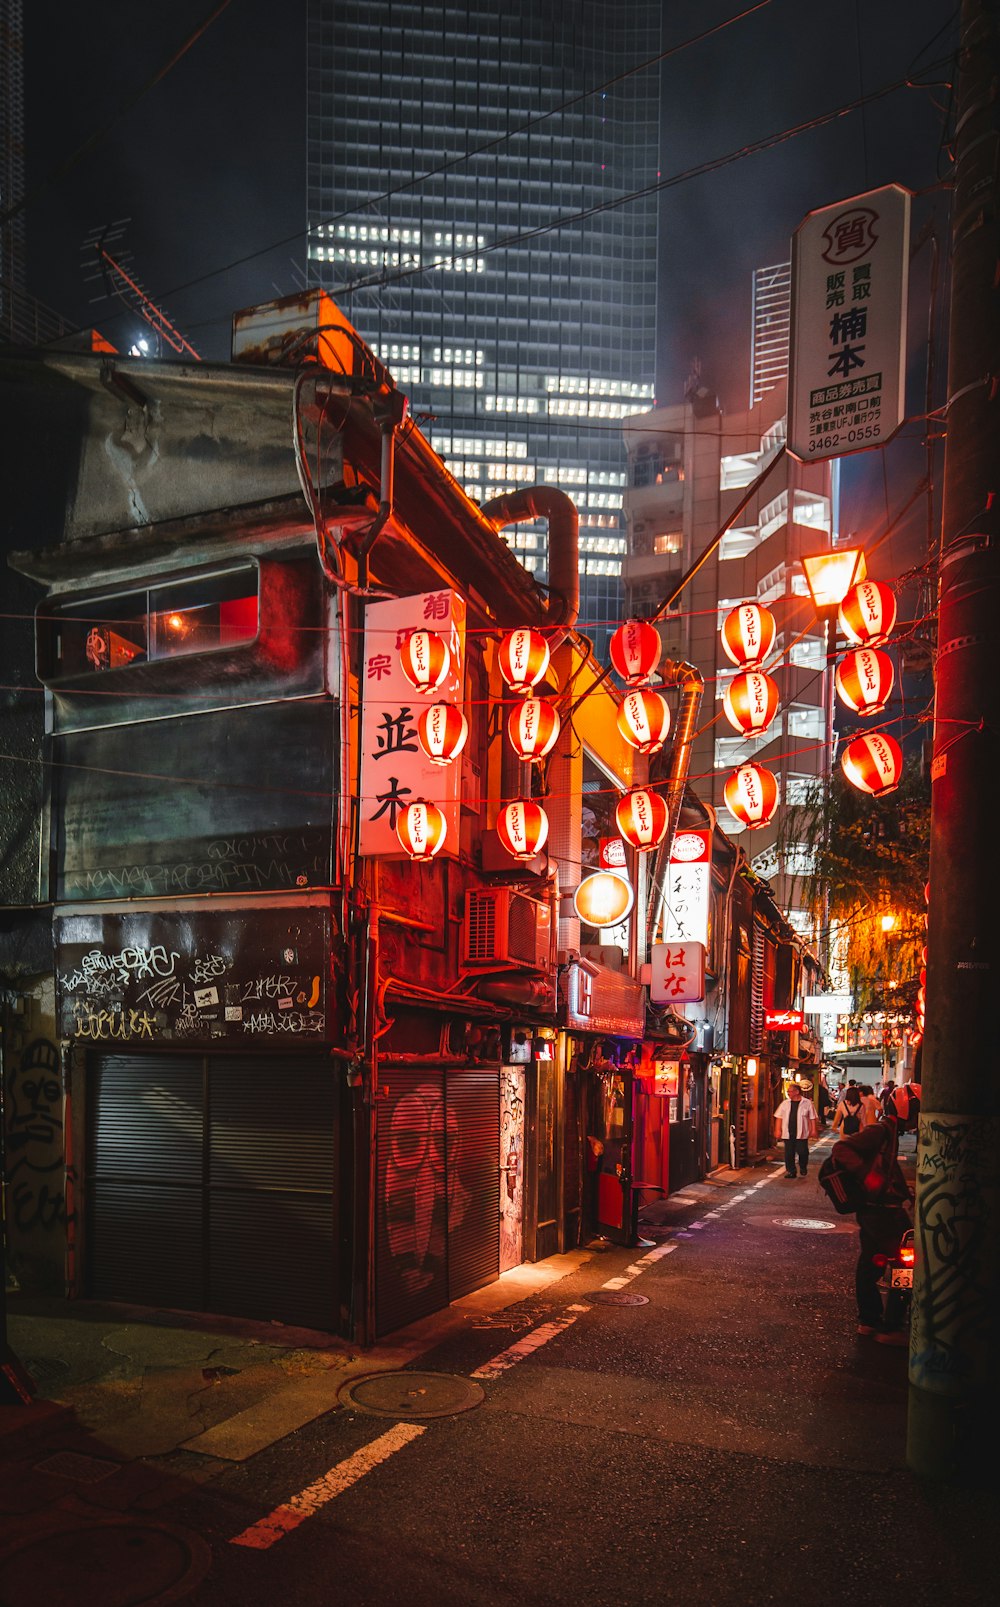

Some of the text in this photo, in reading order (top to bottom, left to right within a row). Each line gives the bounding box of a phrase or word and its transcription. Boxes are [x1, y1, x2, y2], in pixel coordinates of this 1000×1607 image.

[835, 215, 868, 256] 質
[826, 270, 845, 310] 販売
[852, 262, 871, 300] 買取
[827, 306, 868, 378] 楠本
[809, 395, 881, 424] 渋谷駅南口前
[812, 376, 880, 405] 商品券売買
[809, 424, 881, 452] 3462-0555
[744, 607, 757, 646] キリンビール
[416, 634, 426, 671] キリンビール
[515, 631, 524, 670] キリンビール
[751, 676, 765, 714] キリンビール
[432, 707, 442, 745] キリンビール
[525, 703, 536, 740] キリンビール
[368, 707, 420, 831] 並木
[742, 772, 758, 810] キリンビール
[413, 806, 423, 844] キリンビール
[510, 805, 522, 842] キリンビール
[635, 794, 649, 832] キリンビール
[663, 947, 686, 996] はな
